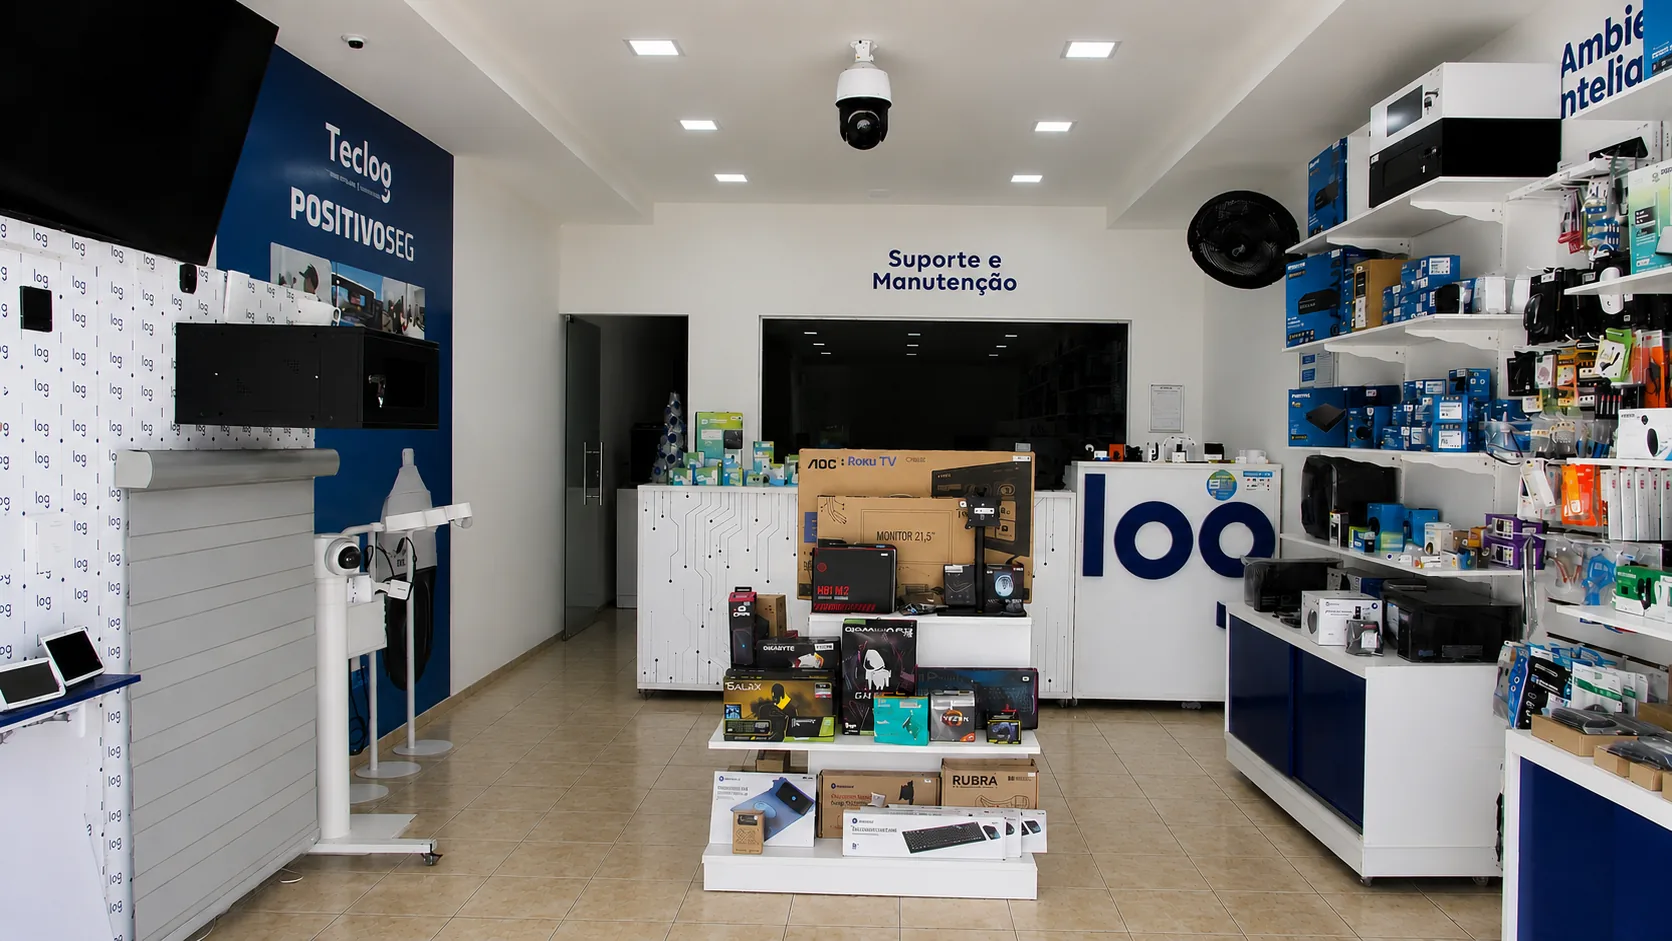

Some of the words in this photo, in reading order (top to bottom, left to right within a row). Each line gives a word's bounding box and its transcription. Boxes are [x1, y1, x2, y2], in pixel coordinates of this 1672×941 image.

[325, 122, 392, 203] Teclog
[290, 186, 414, 261] POSITIVOSEG
[32, 228, 48, 249] log
[71, 237, 86, 257] log
[110, 245, 125, 265] log
[143, 254, 156, 271] log
[888, 249, 981, 272] Suporte
[988, 254, 1002, 268] e
[33, 269, 49, 290] log
[71, 276, 87, 296] log
[872, 272, 1018, 296] Manutenção
[110, 281, 124, 301] log
[142, 289, 155, 307] log
[71, 308, 87, 329] log
[110, 313, 124, 332] log
[141, 319, 155, 337] log
[33, 344, 49, 364] log
[71, 348, 87, 367] log
[109, 352, 123, 370] log
[141, 355, 154, 373] log
[34, 379, 50, 398] log
[72, 381, 87, 399] log
[109, 383, 123, 401] log
[140, 385, 154, 402] log
[34, 419, 50, 438] log
[72, 420, 87, 438] log
[108, 420, 123, 437] log
[140, 420, 154, 437] log
[34, 451, 50, 470] log
[72, 450, 87, 468] log
[108, 449, 118, 461] lo
[807, 458, 837, 470] AOC
[847, 456, 876, 467] Roku
[879, 456, 897, 467] TV
[34, 491, 51, 510] log
[73, 489, 88, 506] log
[108, 487, 122, 503] log
[73, 520, 88, 536] log
[107, 515, 121, 531] log
[876, 531, 913, 542] MONITOR
[73, 558, 89, 573] log
[107, 552, 121, 567] log
[73, 588, 89, 604] log
[107, 581, 121, 596] log
[36, 595, 52, 611] log
[107, 617, 121, 631] log
[107, 647, 121, 660] log
[107, 711, 121, 724] log
[107, 746, 122, 760] log
[107, 775, 122, 788] log
[952, 775, 998, 787] RUBRA
[108, 809, 122, 825] log
[108, 838, 123, 851] log
[109, 872, 123, 886] log
[109, 900, 123, 915] log
